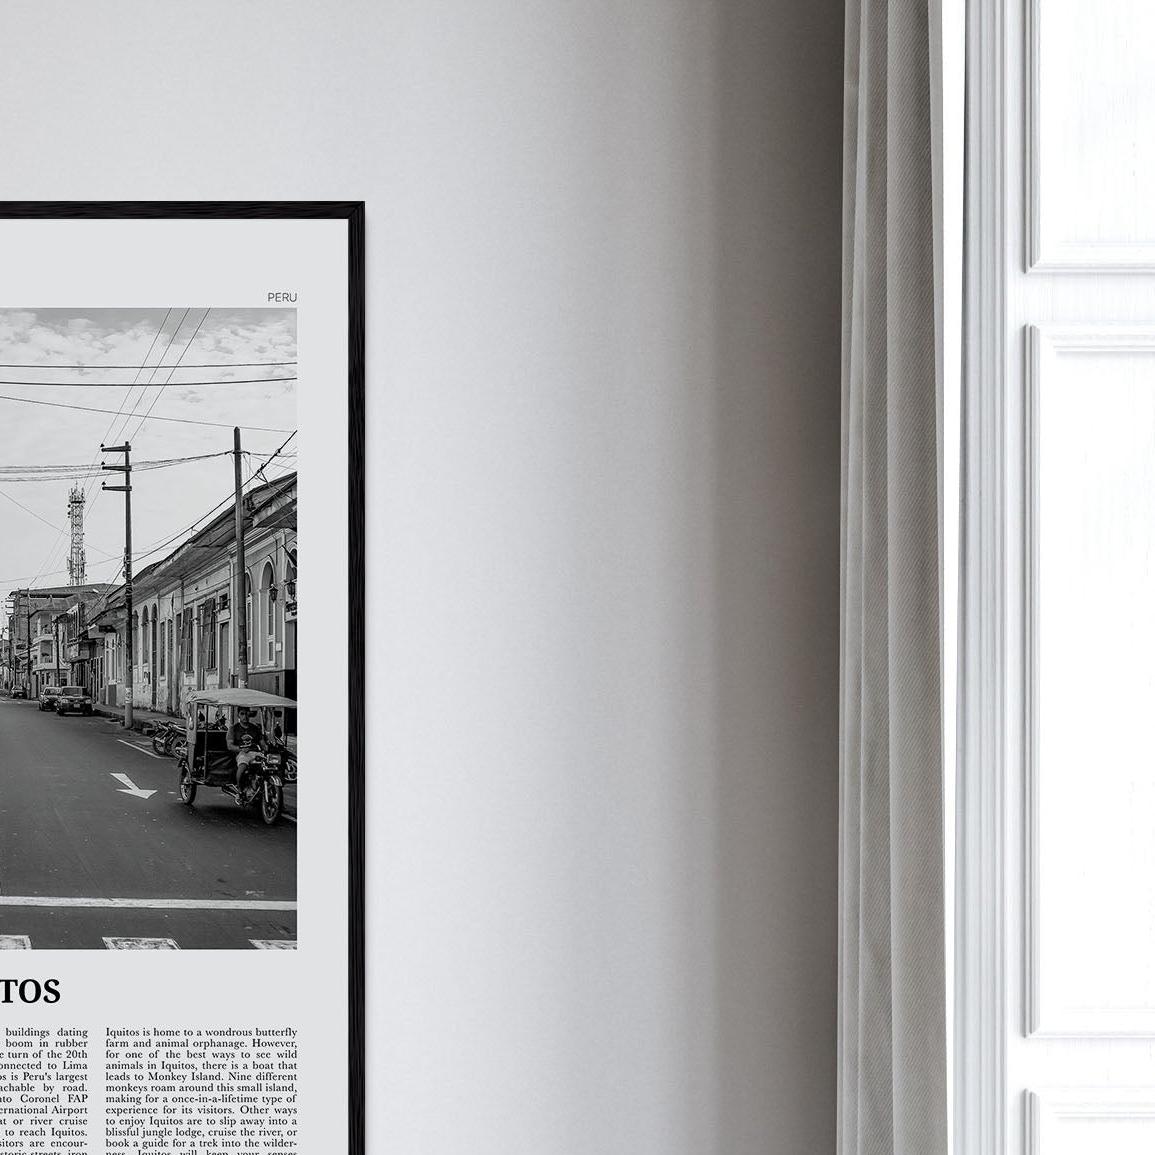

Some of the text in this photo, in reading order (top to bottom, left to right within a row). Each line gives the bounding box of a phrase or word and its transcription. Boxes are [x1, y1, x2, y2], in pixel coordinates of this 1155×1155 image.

[268, 292, 297, 302] PERU
[5, 1027, 50, 1039] buildings
[56, 1027, 88, 1039] dating
[106, 1027, 140, 1039] Iquitos
[142, 1027, 151, 1037] is
[153, 1027, 181, 1037] home
[183, 1029, 194, 1037] to
[205, 1027, 253, 1037] wondrous
[255, 1027, 298, 1039] butterfly
[5, 1038, 33, 1048] boom
[39, 1038, 49, 1048] in
[55, 1038, 88, 1048] rubber
[105, 1038, 297, 1050] farm and animal orphanage. However,
[63, 1061, 88, 1070] Lima
[105, 1061, 144, 1070] animals
[147, 1061, 157, 1070] in
[161, 1061, 198, 1072] Iquitos,
[202, 1061, 227, 1070] there
[231, 1061, 239, 1070] is
[252, 1061, 274, 1070] boat
[278, 1061, 298, 1070] that
[105, 1072, 131, 1081] leads
[148, 1072, 188, 1083] Monkey
[191, 1072, 224, 1081] Island.
[228, 1072, 252, 1081] Nine
[255, 1072, 297, 1081] different
[43, 1083, 55, 1094] by
[62, 1083, 88, 1092] road.
[105, 1083, 148, 1094] monkeys
[178, 1083, 214, 1092] around
[216, 1083, 235, 1092] this
[236, 1083, 263, 1092] small
[265, 1083, 298, 1093] island,
[20, 1094, 60, 1103] Coronel
[68, 1094, 88, 1103] FAP
[51, 1105, 88, 1116] Airport
[105, 1105, 298, 1116] experience for its visitors. Other ways
[105, 1127, 139, 1136] blissful
[142, 1127, 173, 1139] jungle
[175, 1127, 205, 1139] lodge,
[208, 1127, 237, 1136] cruise
[240, 1127, 255, 1136] the
[258, 1127, 284, 1137] river,
